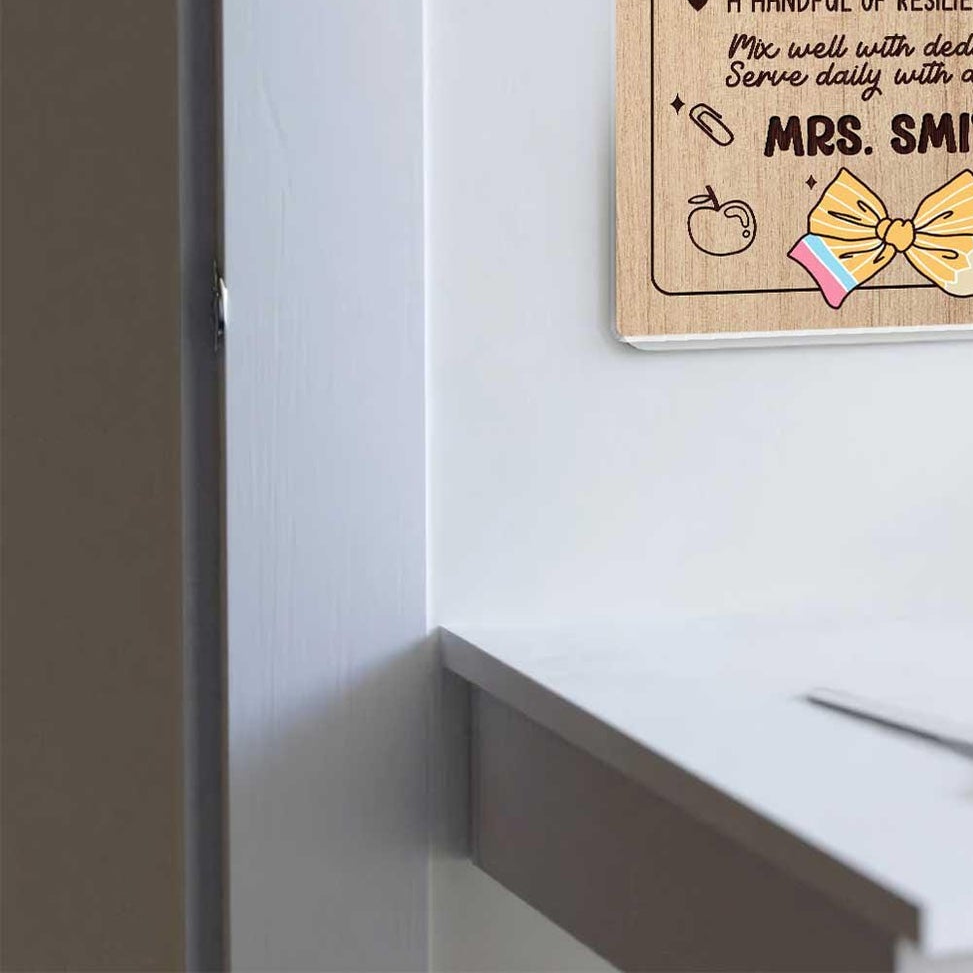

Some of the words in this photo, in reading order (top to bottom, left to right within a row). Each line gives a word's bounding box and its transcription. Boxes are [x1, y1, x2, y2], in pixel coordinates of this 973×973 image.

[728, 33, 781, 60] Mix
[787, 34, 849, 59] well
[855, 33, 916, 59] with
[725, 60, 809, 88] Serve
[815, 62, 883, 102] daily
[893, 61, 954, 86] with
[763, 114, 873, 158] MRS.
